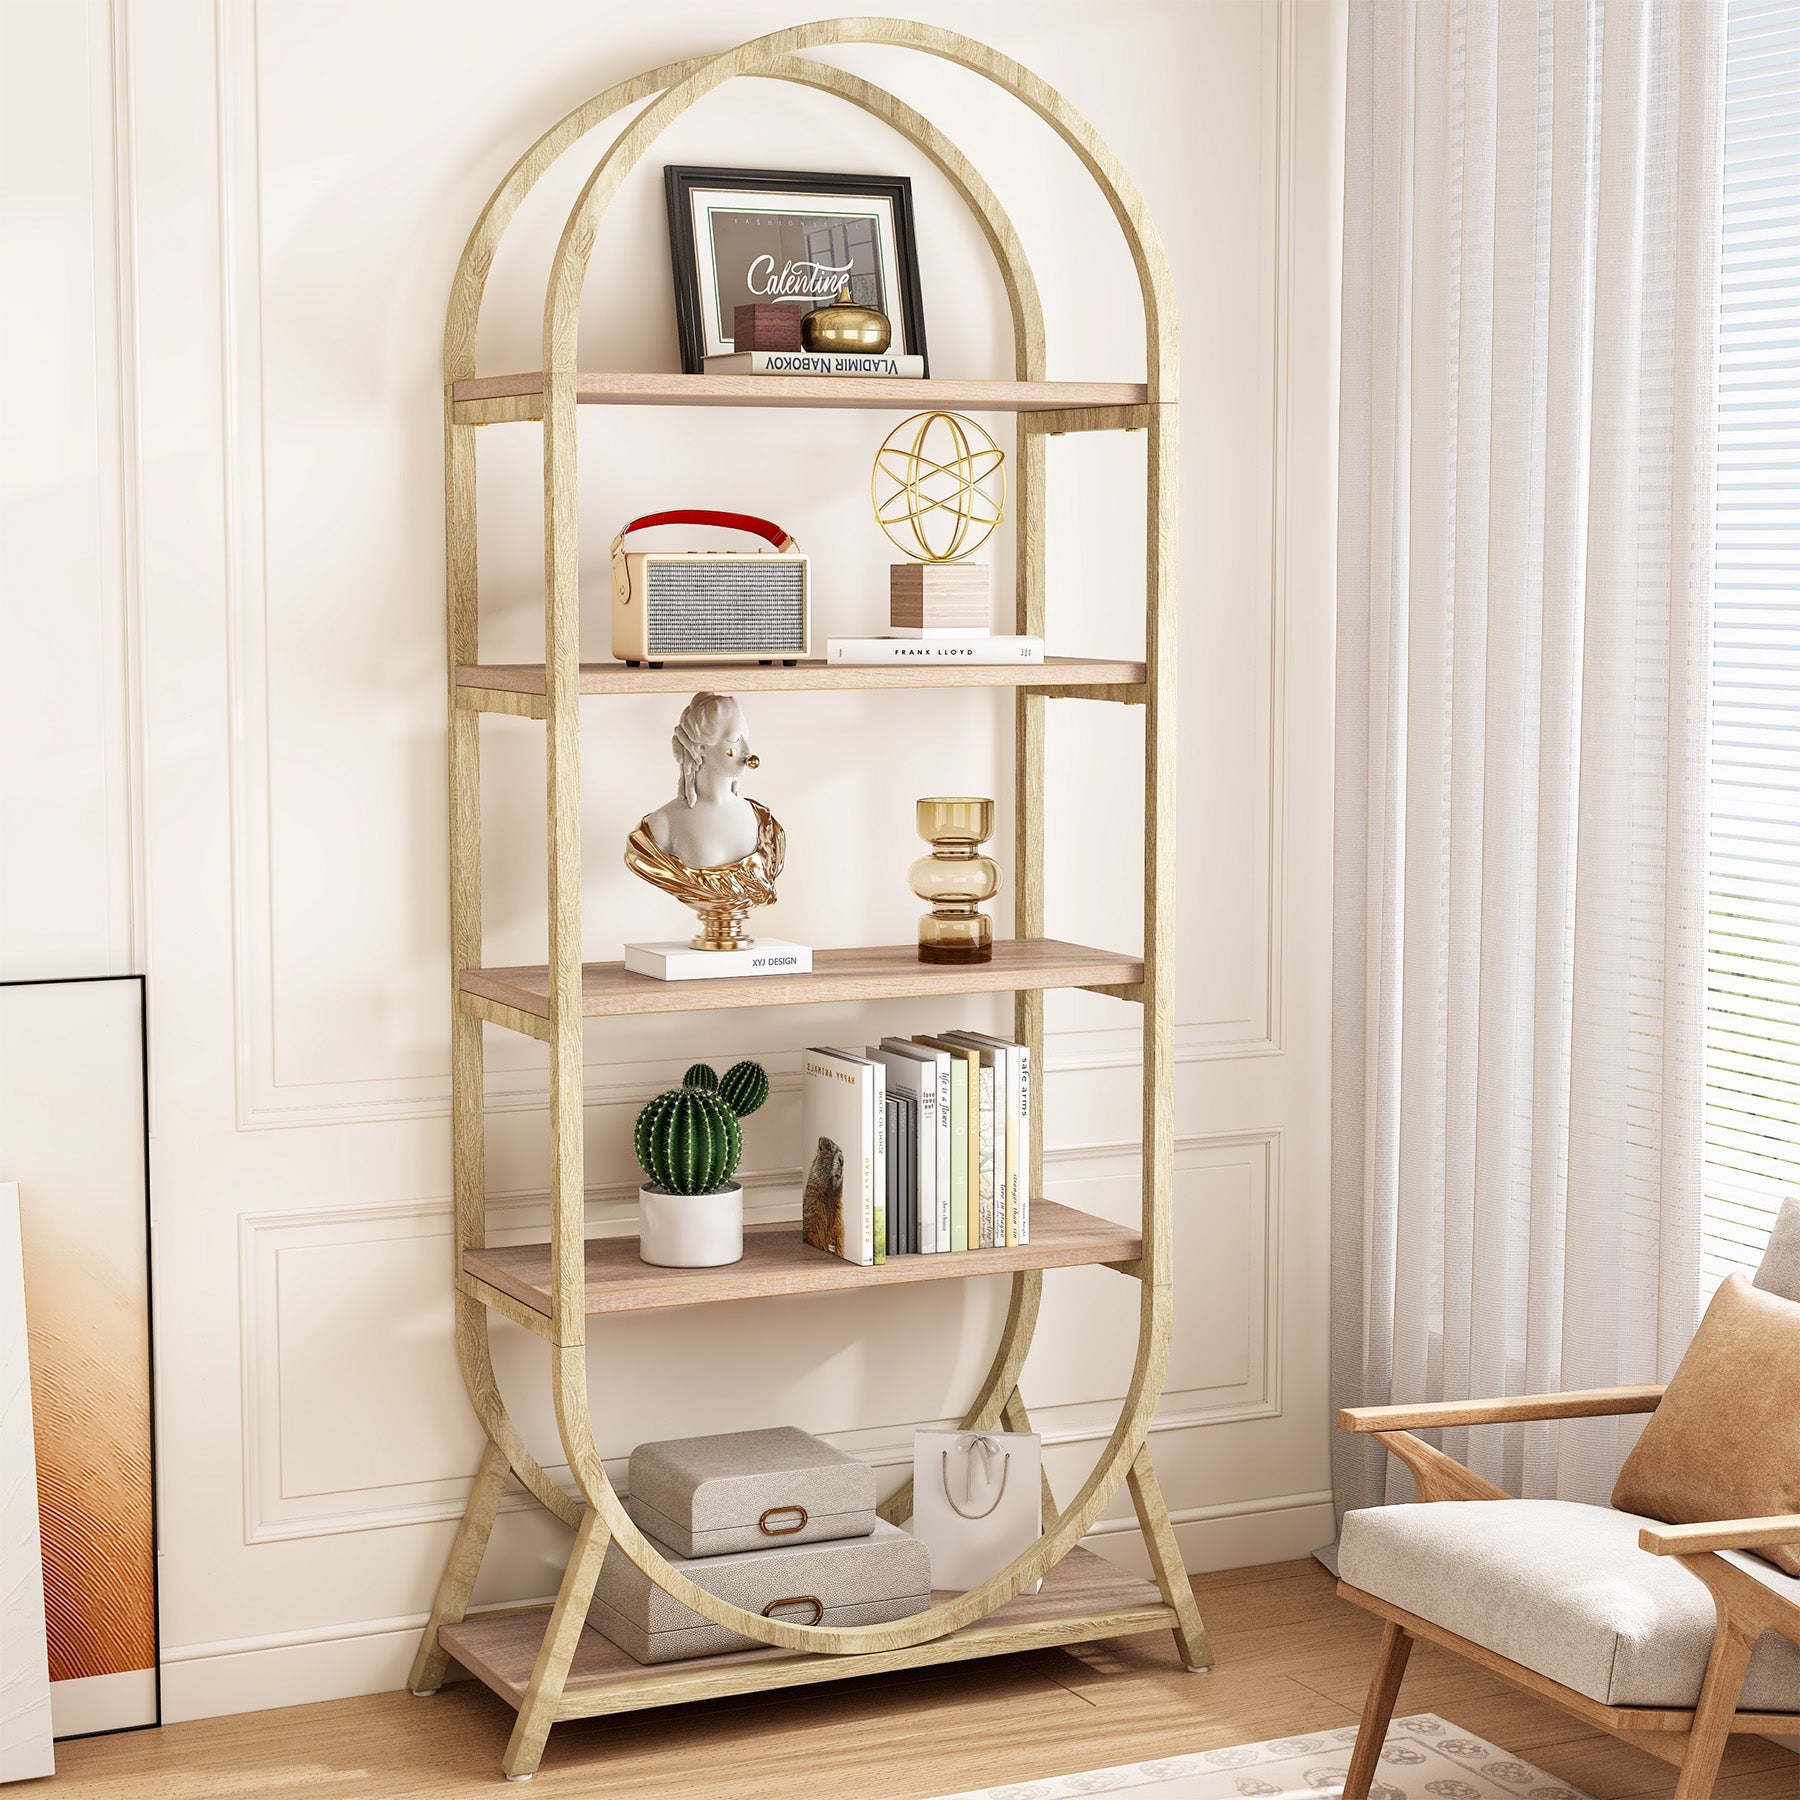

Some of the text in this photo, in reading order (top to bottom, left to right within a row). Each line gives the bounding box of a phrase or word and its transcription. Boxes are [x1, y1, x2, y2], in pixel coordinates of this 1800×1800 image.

[766, 356, 899, 375] VLADIMIR NABOKOV
[752, 956, 797, 967] XYJ DESIGN
[1021, 1057, 1029, 1082] safe
[939, 1072, 950, 1086] life
[939, 1103, 950, 1128] flower
[1000, 1201, 1005, 1210] in
